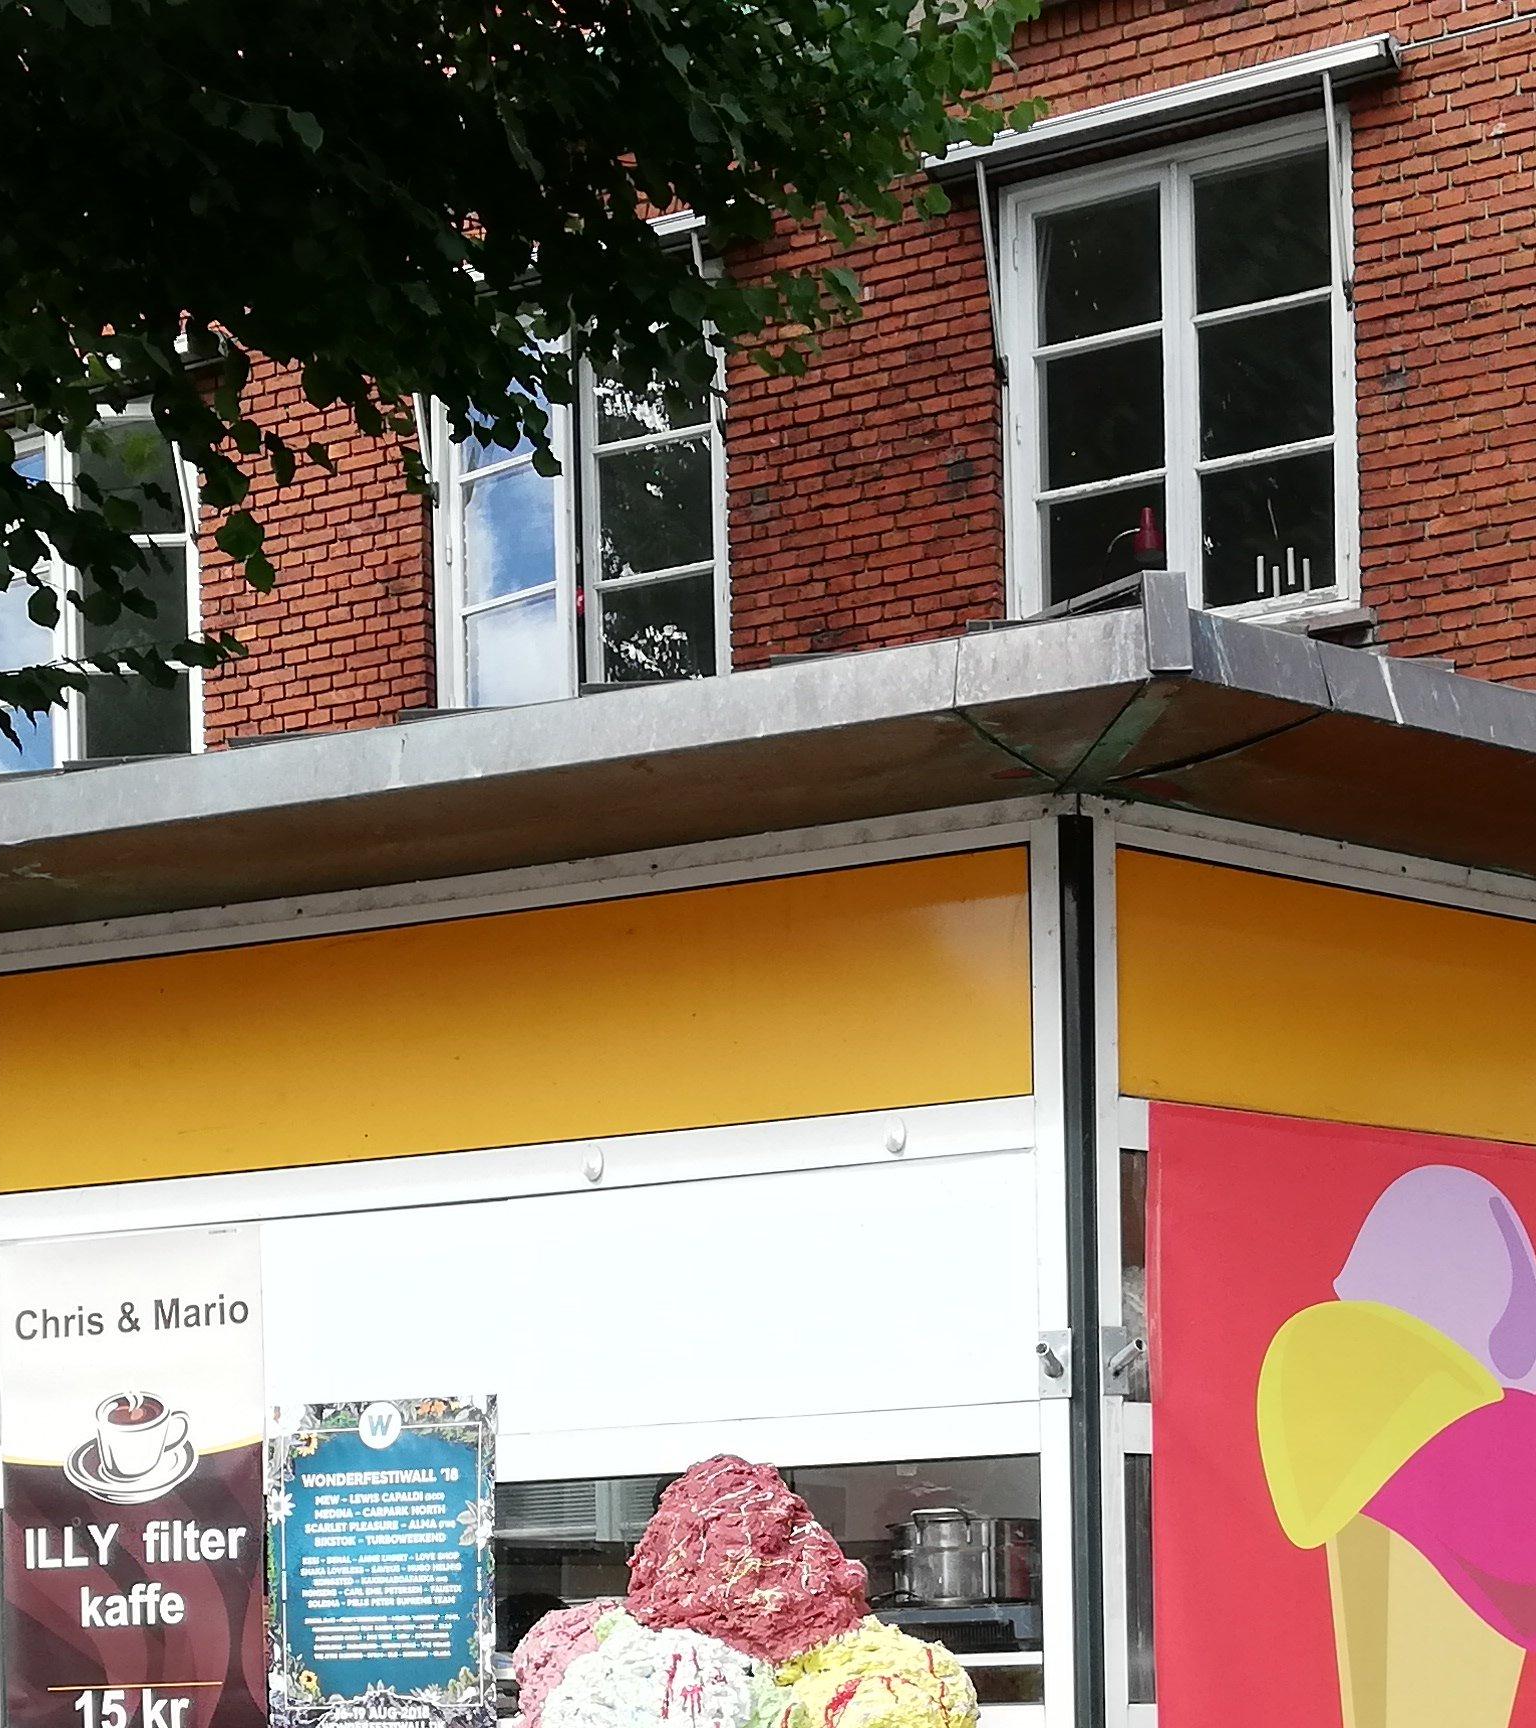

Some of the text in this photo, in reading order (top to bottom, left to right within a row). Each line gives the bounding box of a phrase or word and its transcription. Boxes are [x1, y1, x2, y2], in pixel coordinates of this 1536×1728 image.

[15, 1294, 249, 1340] Chris & Mario
[368, 1414, 393, 1437] W
[301, 1468, 437, 1488] WONDERFESTIWALL
[24, 1520, 247, 1571] ILLY filter
[80, 1584, 185, 1628] kaffe
